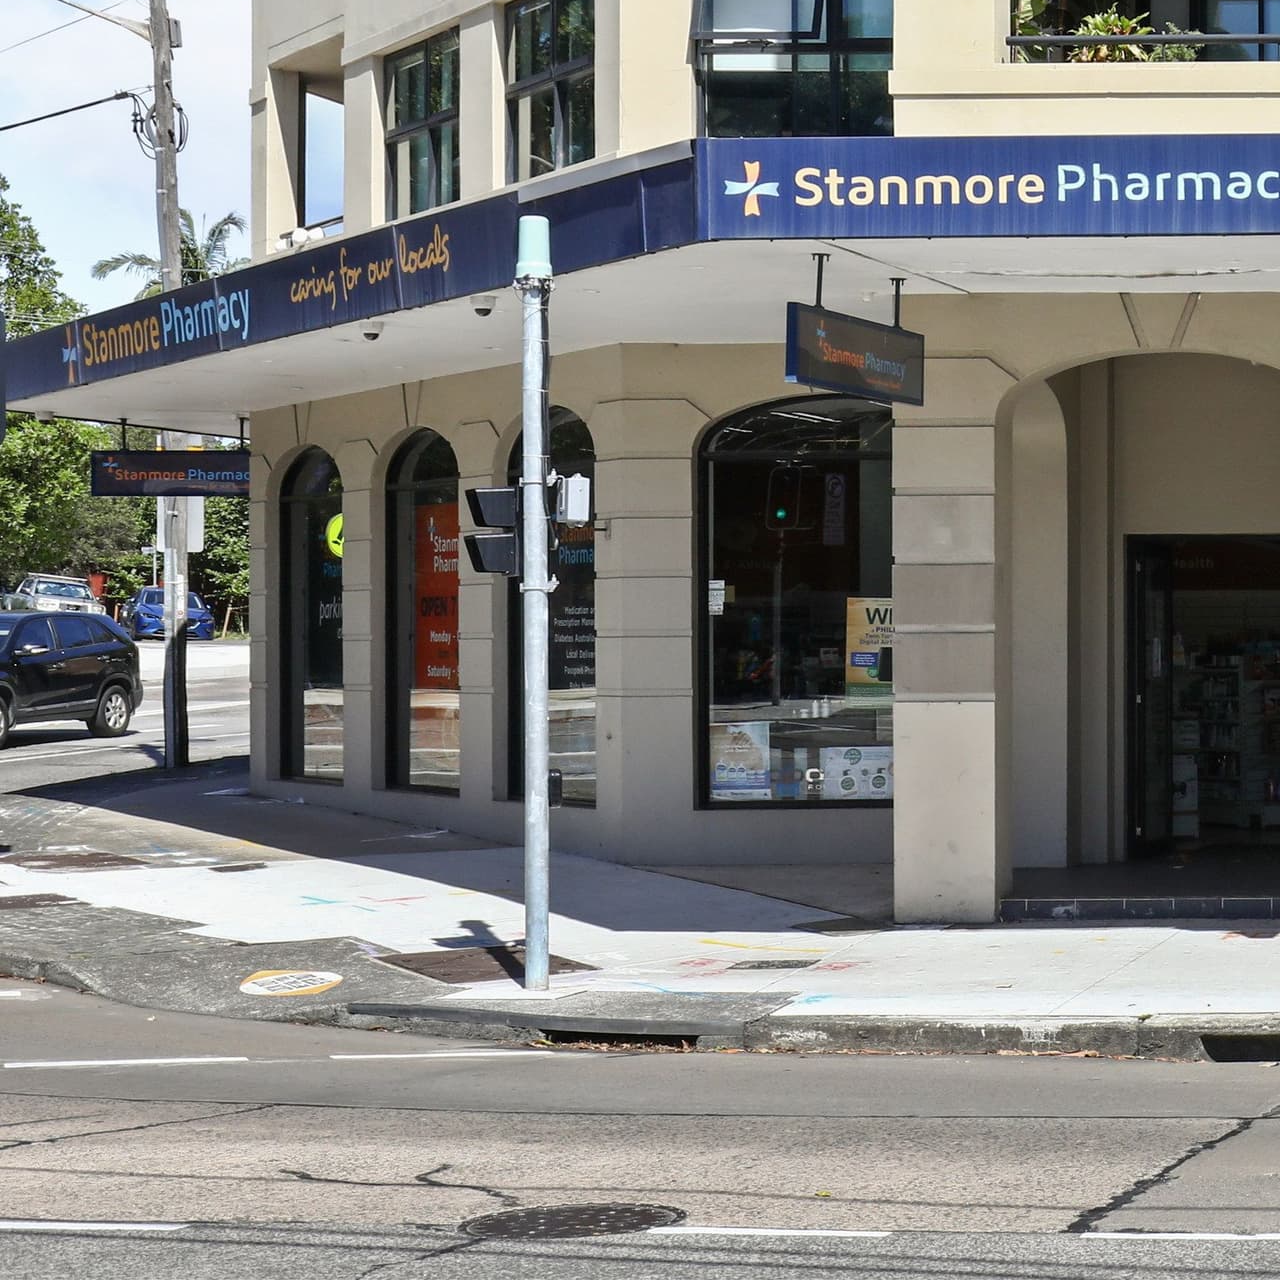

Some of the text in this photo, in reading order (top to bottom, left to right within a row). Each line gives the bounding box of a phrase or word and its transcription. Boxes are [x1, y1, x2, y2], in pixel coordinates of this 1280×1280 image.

[794, 167, 1045, 207] Stanmore
[290, 223, 451, 312] caring for our locals
[82, 287, 250, 367] Stanmore Pharmacy
[823, 342, 906, 381] Stanmore Pharmacy
[115, 469, 186, 481] Stanmore
[430, 630, 451, 643] Monday
